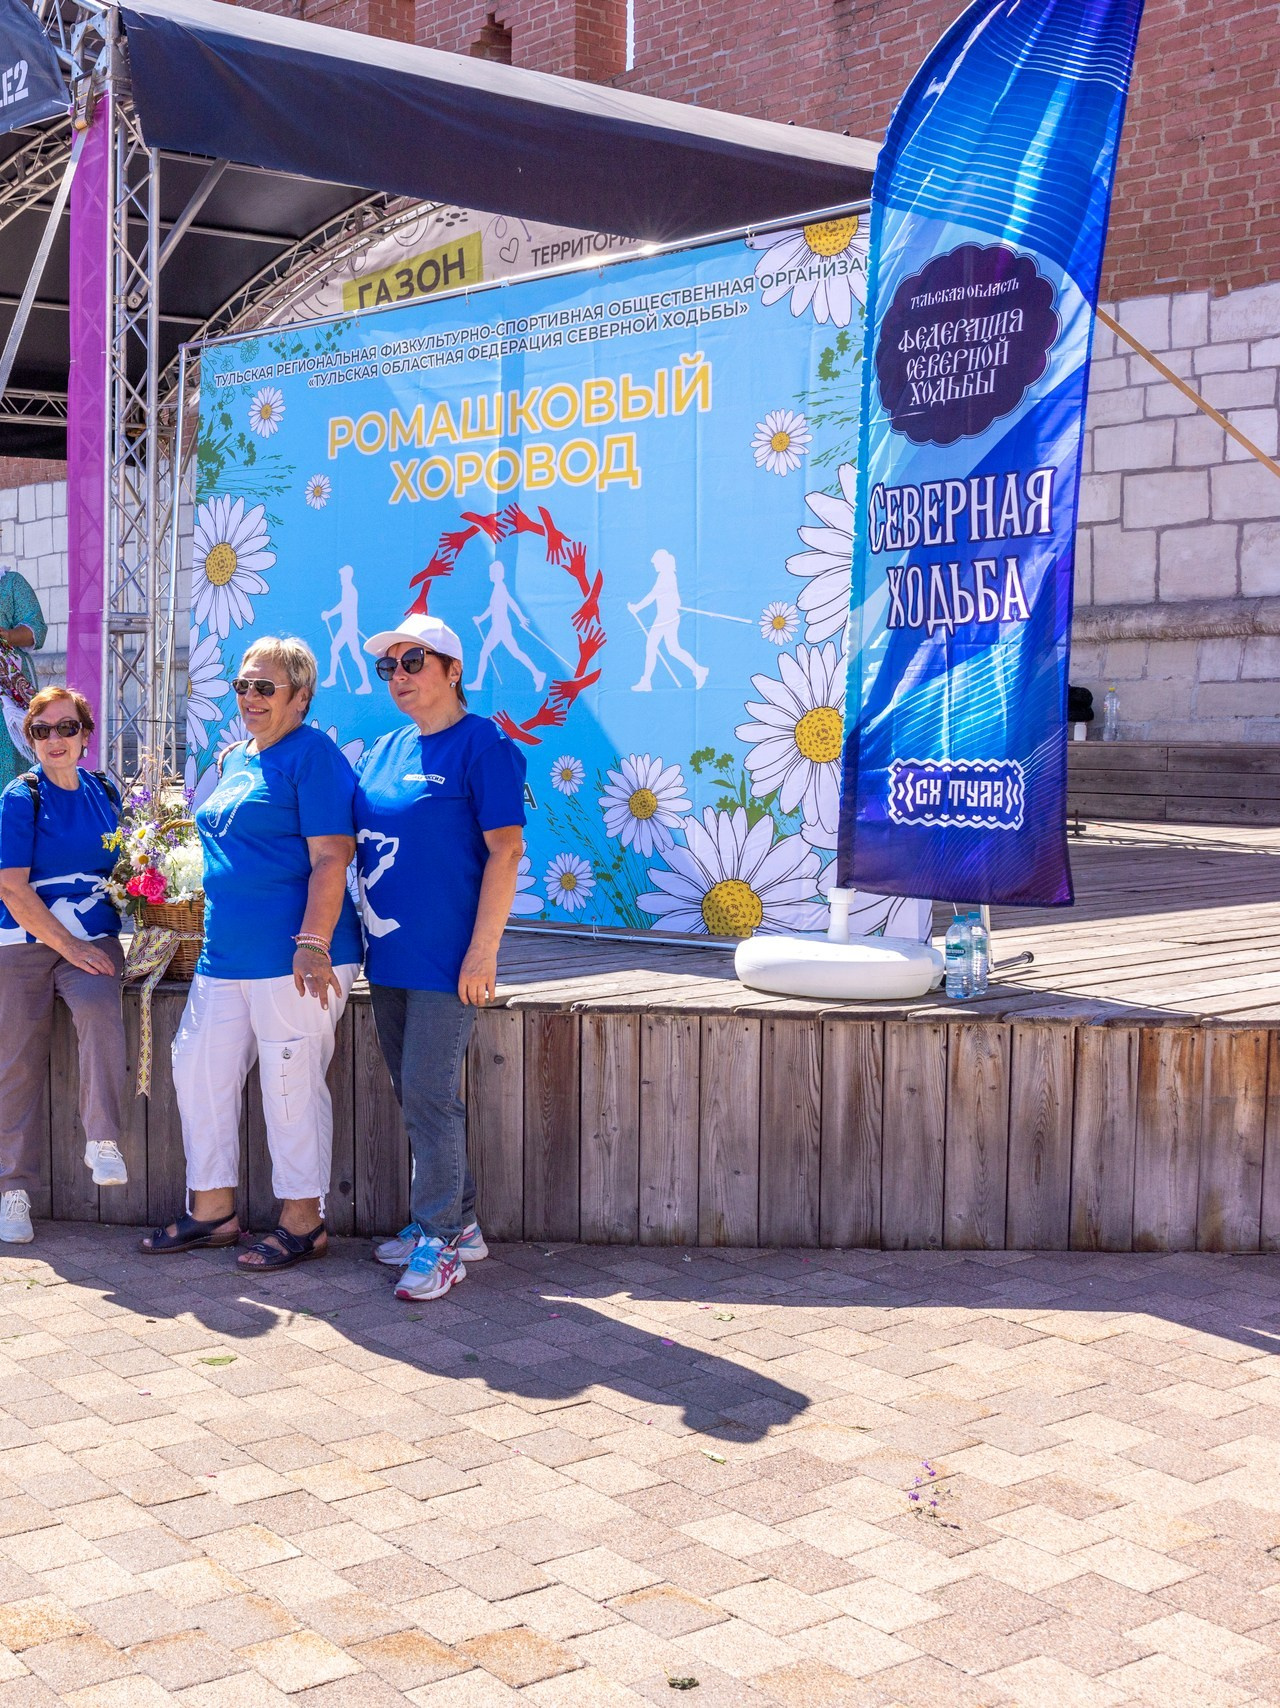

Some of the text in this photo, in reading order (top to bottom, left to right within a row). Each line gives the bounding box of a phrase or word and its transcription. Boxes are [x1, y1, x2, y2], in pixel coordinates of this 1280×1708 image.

[358, 247, 467, 310] ГАЗОН
[531, 231, 637, 267] ТЕРРИТОР
[215, 364, 273, 387] ТУЛЬСКАЯ
[276, 346, 377, 377] РЕГИОНАЛЬНАЯ
[380, 304, 603, 357] ФИЗКУЛЬТУРНО-СПОРТИВНАЯ
[608, 276, 754, 317] ОБЩЕСТВЕННАЯ
[308, 301, 749, 389] «ТУЛЬСКАЯ ОБЛАСТНАЯ ФЕДЕРАЦИЯ СЕВЕРНОЙ ХОДЬБЫ»
[898, 308, 1024, 354] ФЕДЕРАЦИЯ
[906, 336, 1011, 382] СЕВЕРНОЙ
[327, 352, 712, 460] РОМАШКОВЫЙ
[909, 368, 997, 408] ХОДЬБЫ
[389, 432, 641, 505] ХОРОВОД
[869, 467, 1056, 554] СЕВЕРНАЯ
[888, 556, 1030, 637] ХОДЬБА
[916, 779, 1003, 808] СХ ТУЛА
